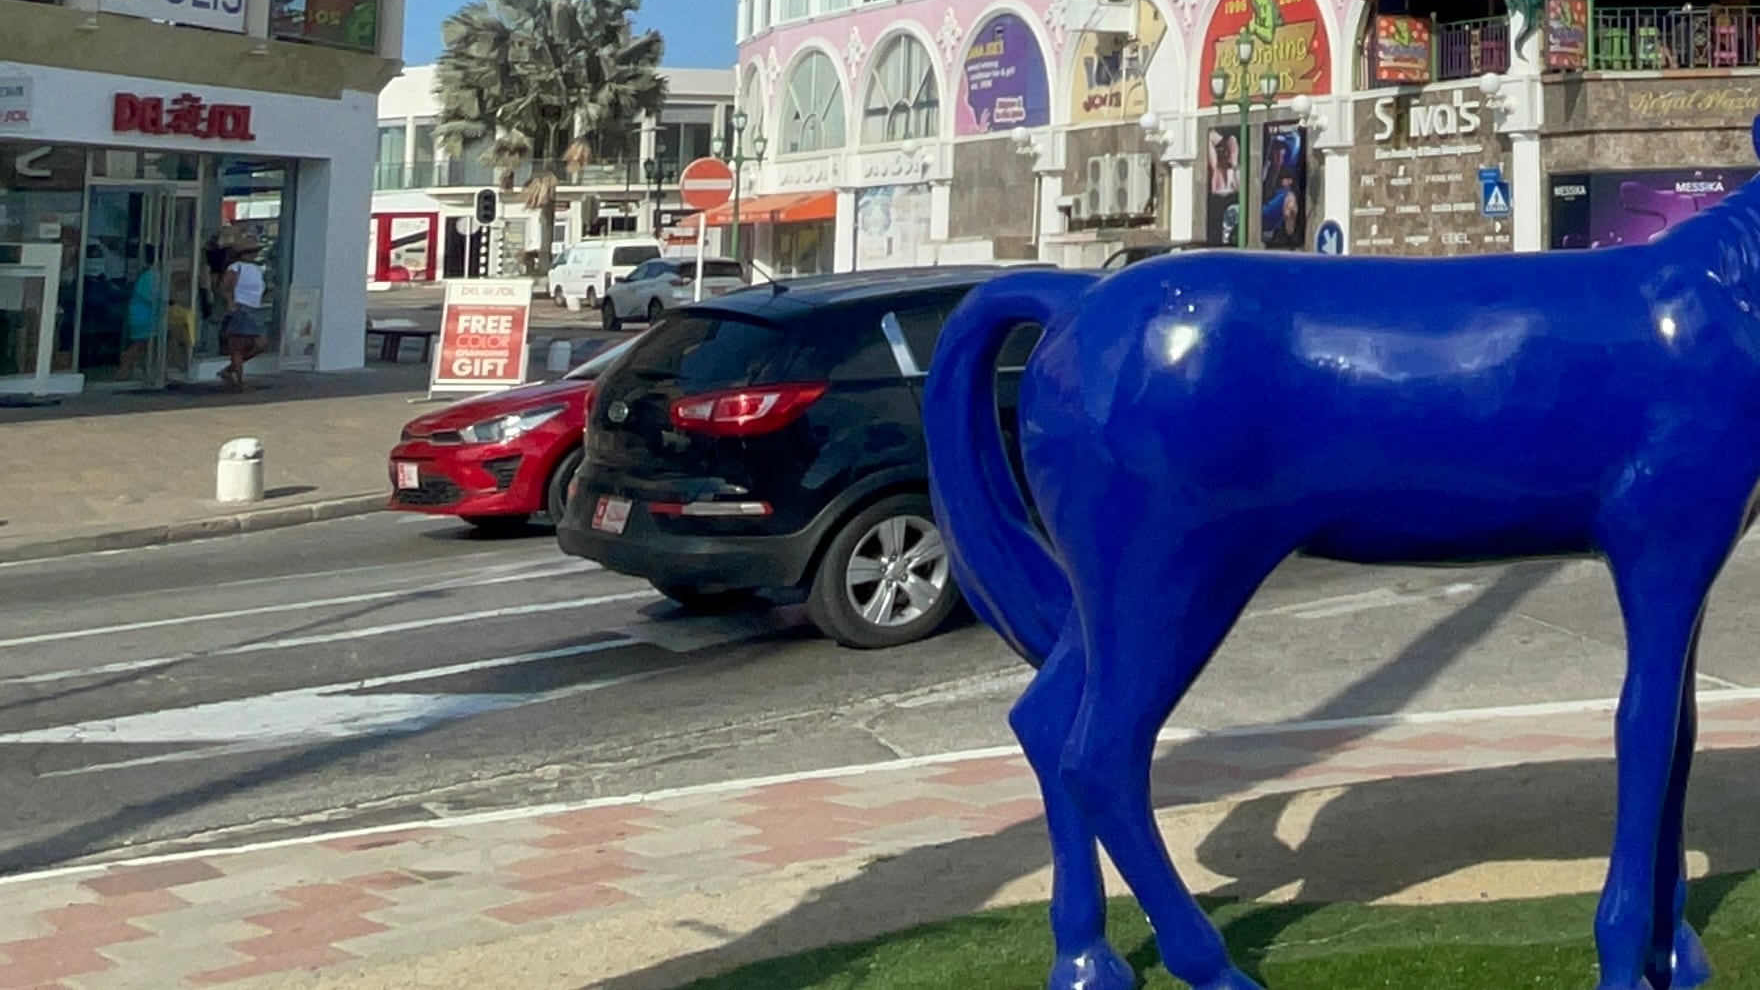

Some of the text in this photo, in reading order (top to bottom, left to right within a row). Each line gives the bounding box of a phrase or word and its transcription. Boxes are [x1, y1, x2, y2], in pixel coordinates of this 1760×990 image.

[1630, 87, 1759, 115] Royal Plaza
[113, 92, 169, 134] DEL
[1554, 185, 1587, 196] MESSIKA
[1675, 182, 1724, 193] MESSIKA
[456, 315, 513, 335] FREE
[455, 335, 511, 348] COLOR
[451, 357, 509, 377] GIFT
